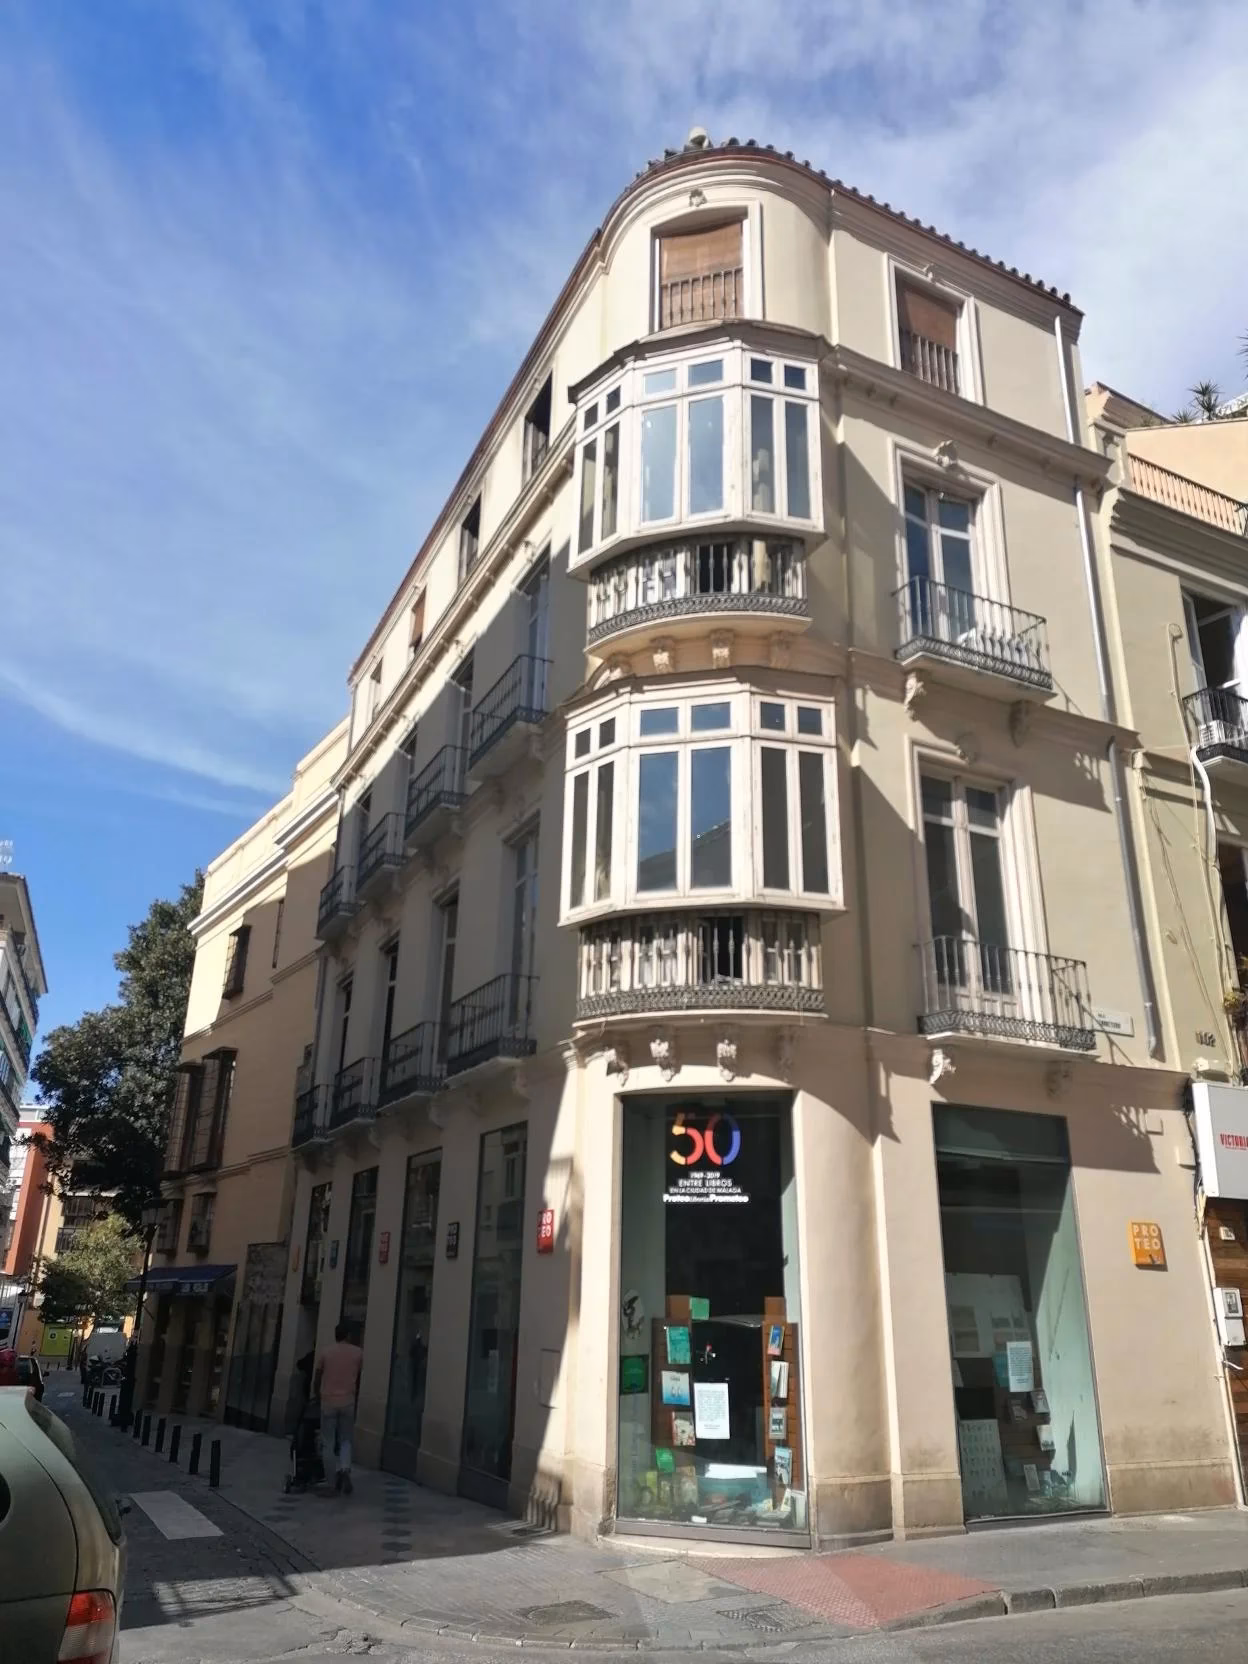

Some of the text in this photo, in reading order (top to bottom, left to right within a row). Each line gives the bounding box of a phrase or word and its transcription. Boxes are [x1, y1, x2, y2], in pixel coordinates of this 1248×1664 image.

[670, 1112, 741, 1165] 50
[678, 1179, 733, 1187] ENTRE LIBROS
[709, 1193, 749, 1203] Prometeo
[1133, 1224, 1159, 1237] PRO
[1135, 1238, 1161, 1251] TEO
